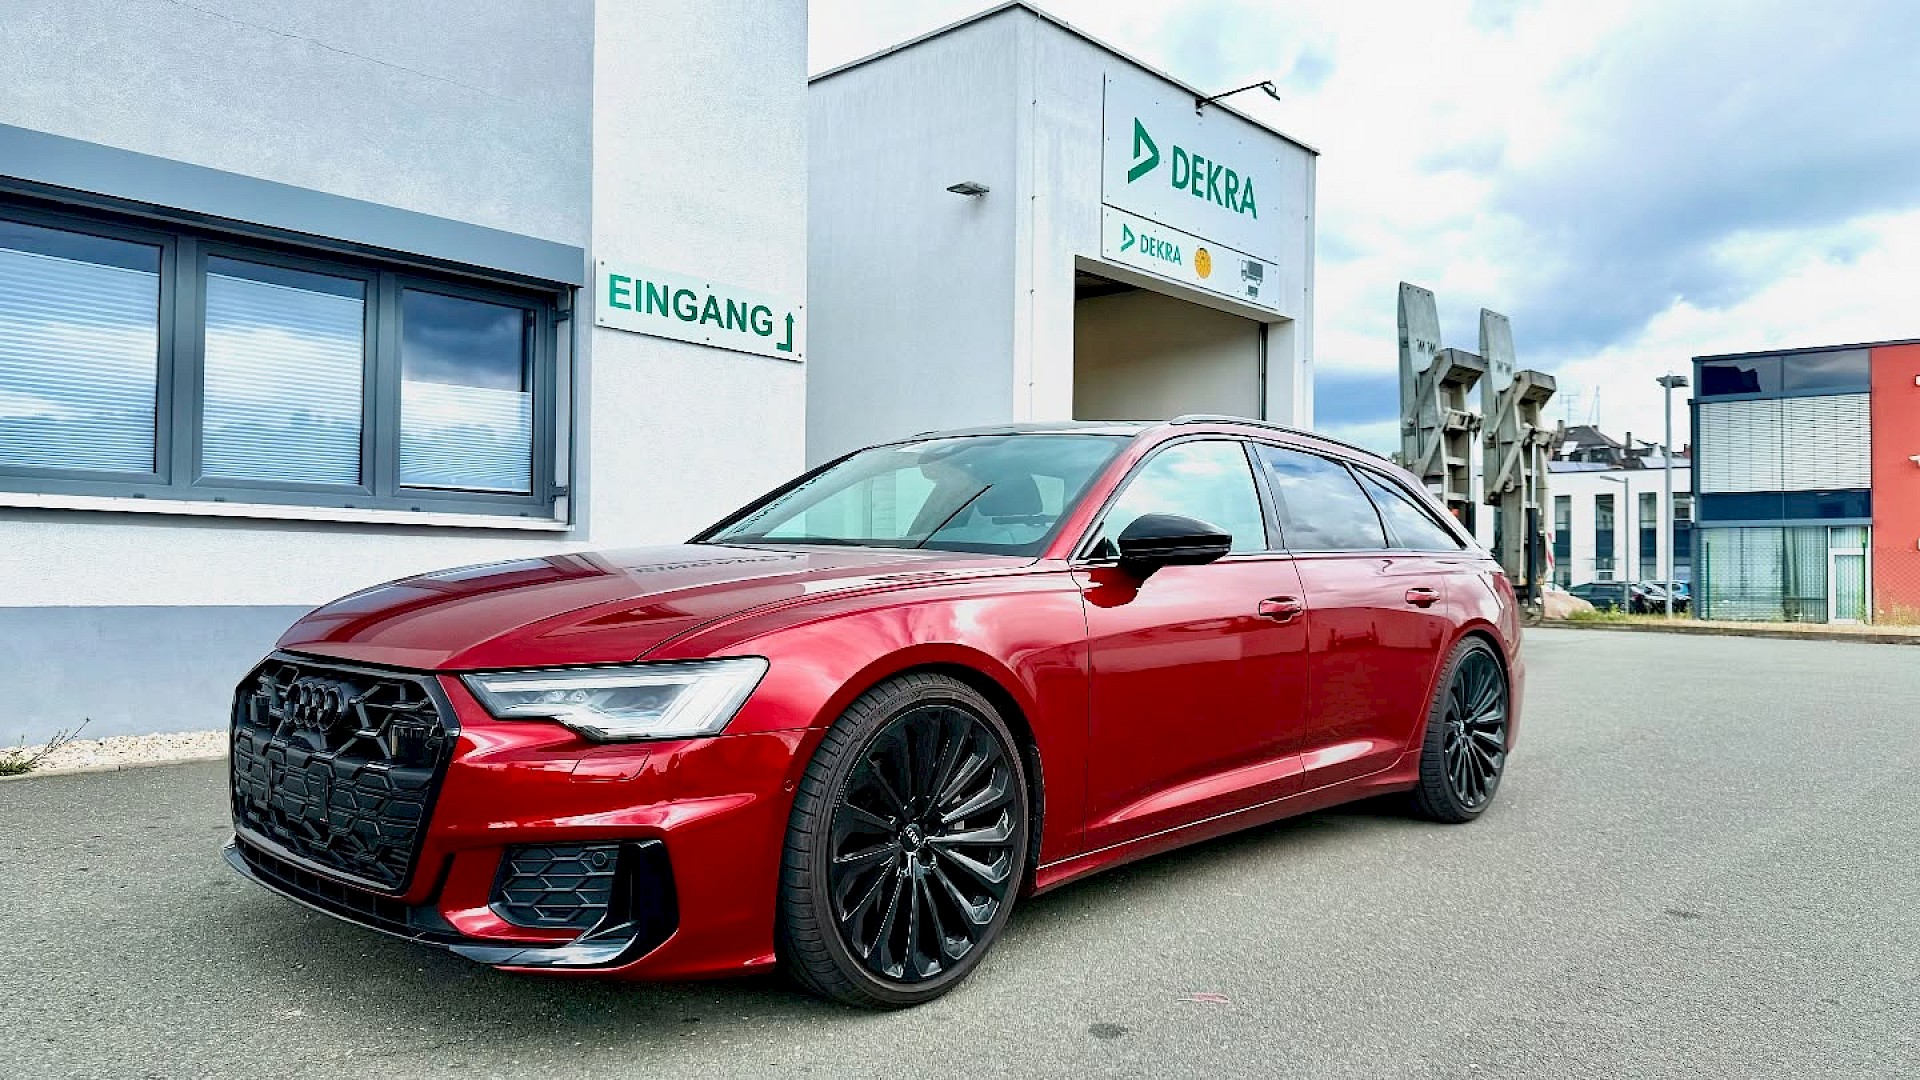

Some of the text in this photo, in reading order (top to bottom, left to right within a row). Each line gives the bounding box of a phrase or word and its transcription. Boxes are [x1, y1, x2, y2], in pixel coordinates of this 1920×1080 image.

[1171, 144, 1257, 219] DEKRA
[1140, 234, 1182, 265] DEKRA
[609, 273, 773, 336] EINGANG
